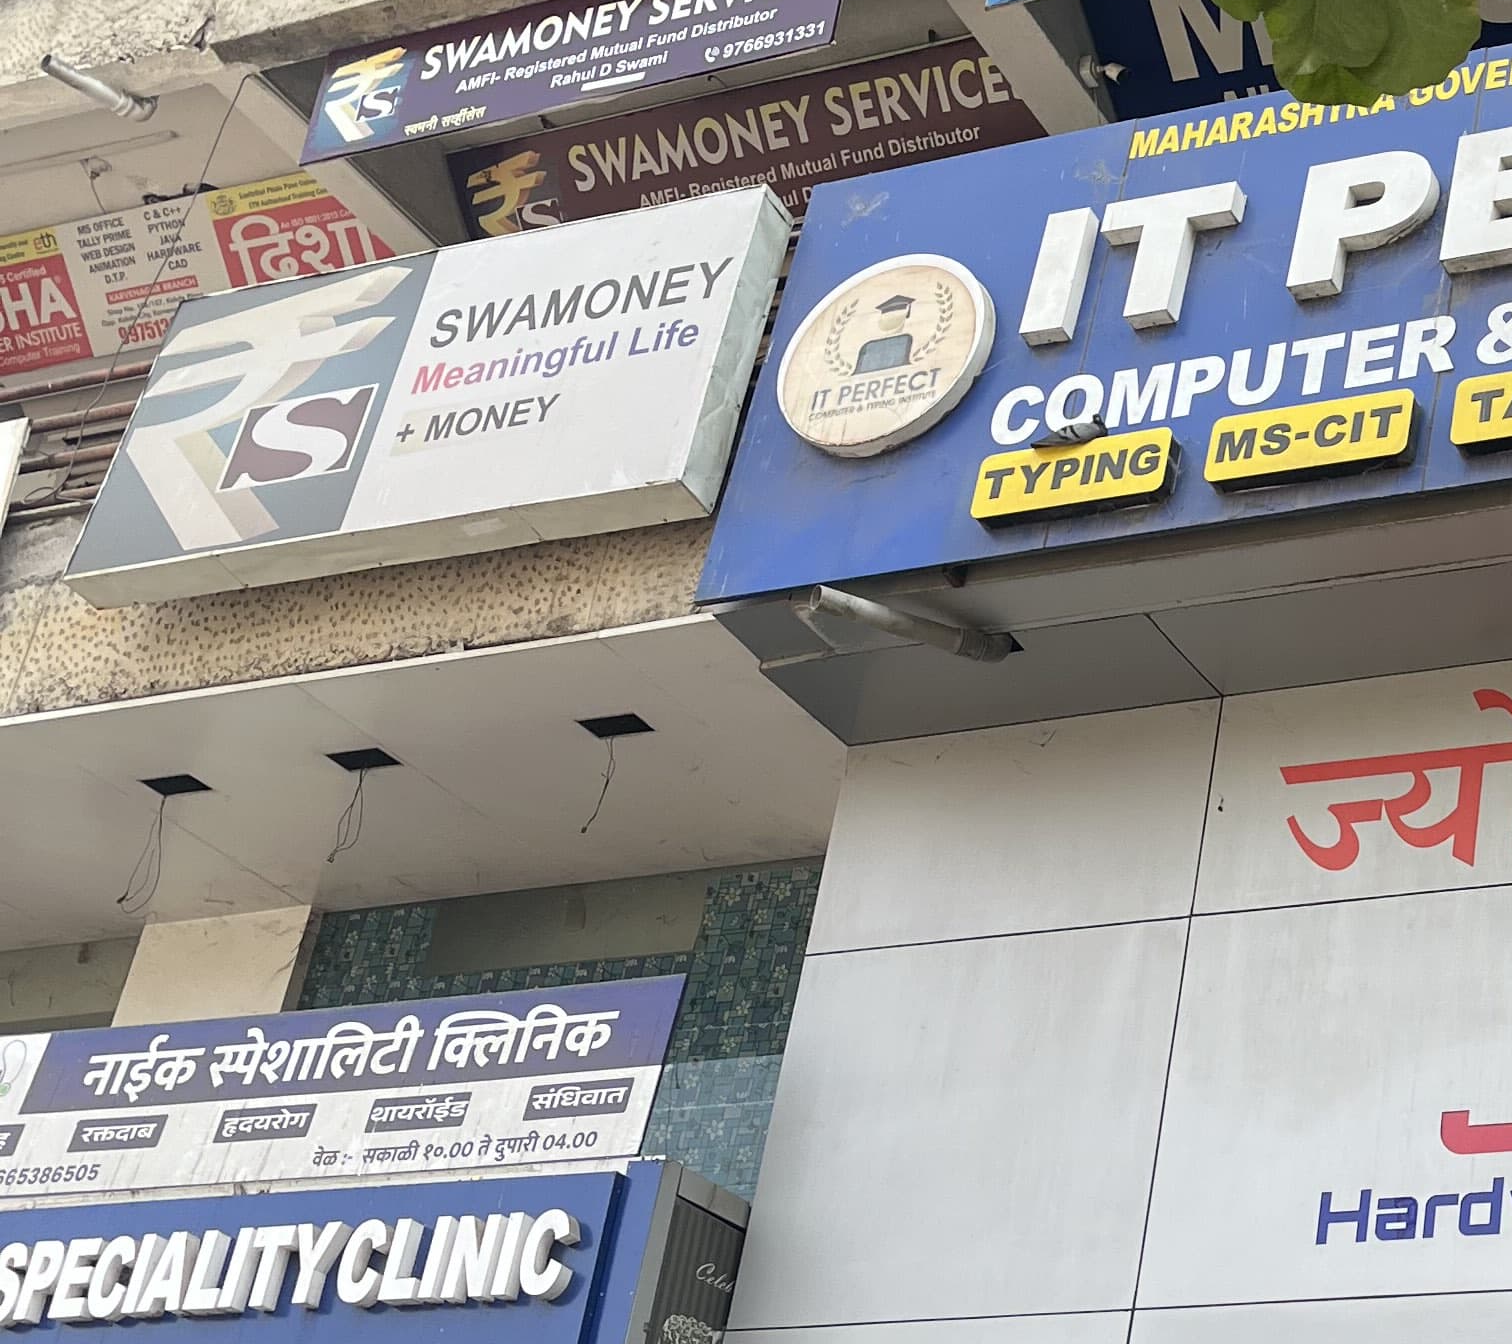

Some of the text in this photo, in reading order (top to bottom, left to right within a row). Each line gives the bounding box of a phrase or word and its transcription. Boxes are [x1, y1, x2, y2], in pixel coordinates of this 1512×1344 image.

[503, 50, 588, 82] Registered
[589, 36, 643, 64] Mutual
[645, 28, 688, 53] Fund
[690, 6, 778, 43] Distributor
[549, 20, 826, 89] Rahul D Swami 9766931331
[568, 95, 812, 193] SWAMONEY
[780, 154, 838, 184] Mutual
[841, 144, 885, 173] Fund
[888, 125, 981, 159] Distributor
[77, 228, 133, 250] TALLY PRIME
[92, 217, 125, 234] OFFICE
[102, 242, 137, 259] DESIGN
[88, 256, 137, 275] ANIMATION
[168, 258, 189, 271] CAD
[1021, 181, 1247, 347] IT
[429, 257, 735, 350] SWAMONEY
[16, 323, 83, 351] INSTITUTE
[410, 318, 702, 397] Meaningful Life
[810, 367, 942, 412] IT PERFECT
[990, 314, 1457, 448] COMPUTER
[424, 392, 564, 447] MONEY
[984, 444, 1162, 502] TYPING
[1214, 403, 1405, 465] MS-CIT
[82, 1005, 621, 1101] नाईक स्पेशालिटी क्लिनिक
[79, 1082, 627, 1146] रक्तदाब हृदयरोग थायरॉईड संधिवात
[361, 1138, 420, 1168] सकाळी
[476, 1130, 494, 1158] ते
[493, 1128, 541, 1163] दुपारी
